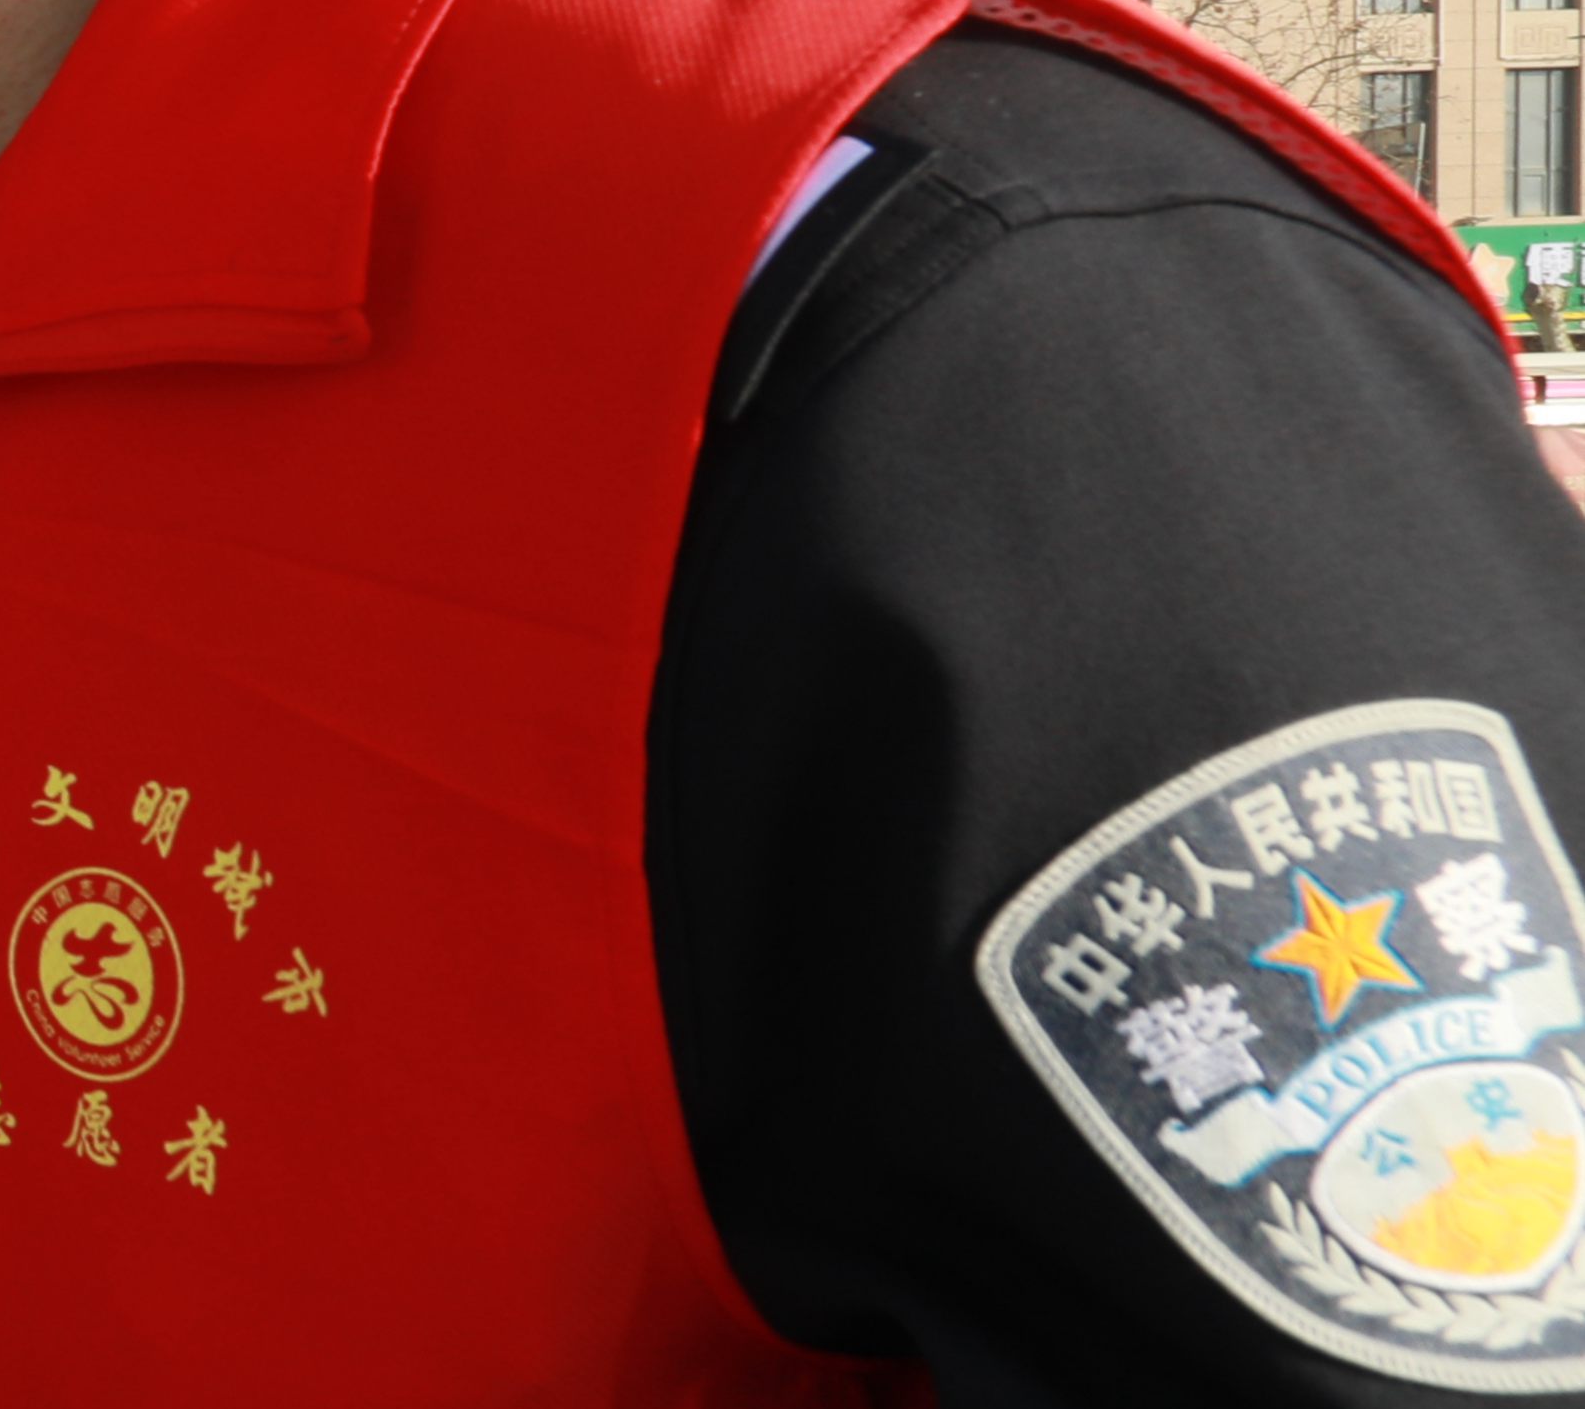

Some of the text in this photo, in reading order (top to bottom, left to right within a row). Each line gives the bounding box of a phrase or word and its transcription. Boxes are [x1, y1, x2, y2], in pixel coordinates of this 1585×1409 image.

[1043, 757, 1505, 1018] 中华人民共和国
[1294, 1004, 1496, 1125] POLICE
